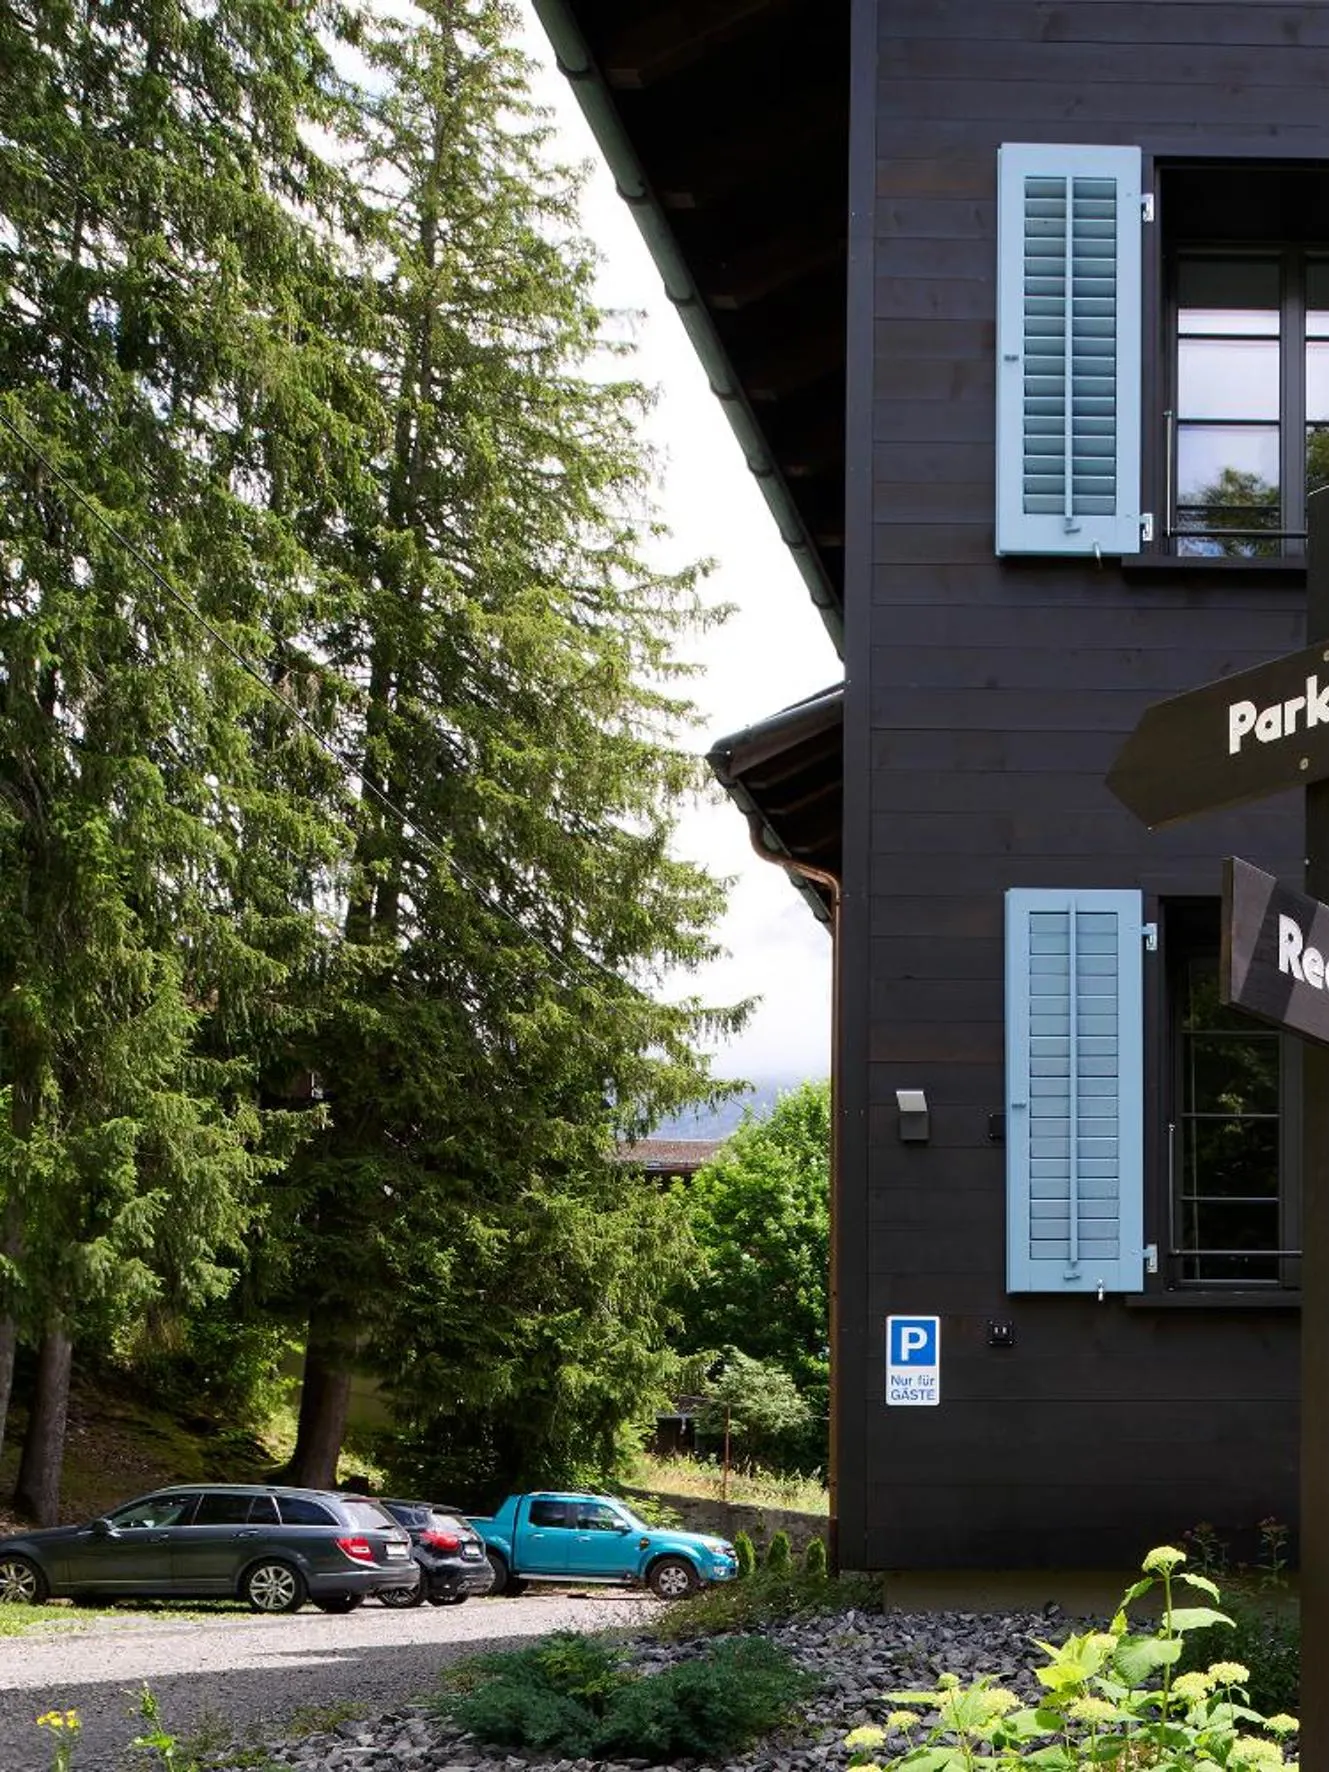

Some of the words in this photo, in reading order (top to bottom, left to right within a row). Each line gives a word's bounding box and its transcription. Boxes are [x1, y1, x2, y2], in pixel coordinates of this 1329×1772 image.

[900, 1326, 928, 1361] P
[890, 1374, 912, 1387] Nur
[918, 1374, 935, 1387] für
[890, 1387, 936, 1401] GÄSTE
